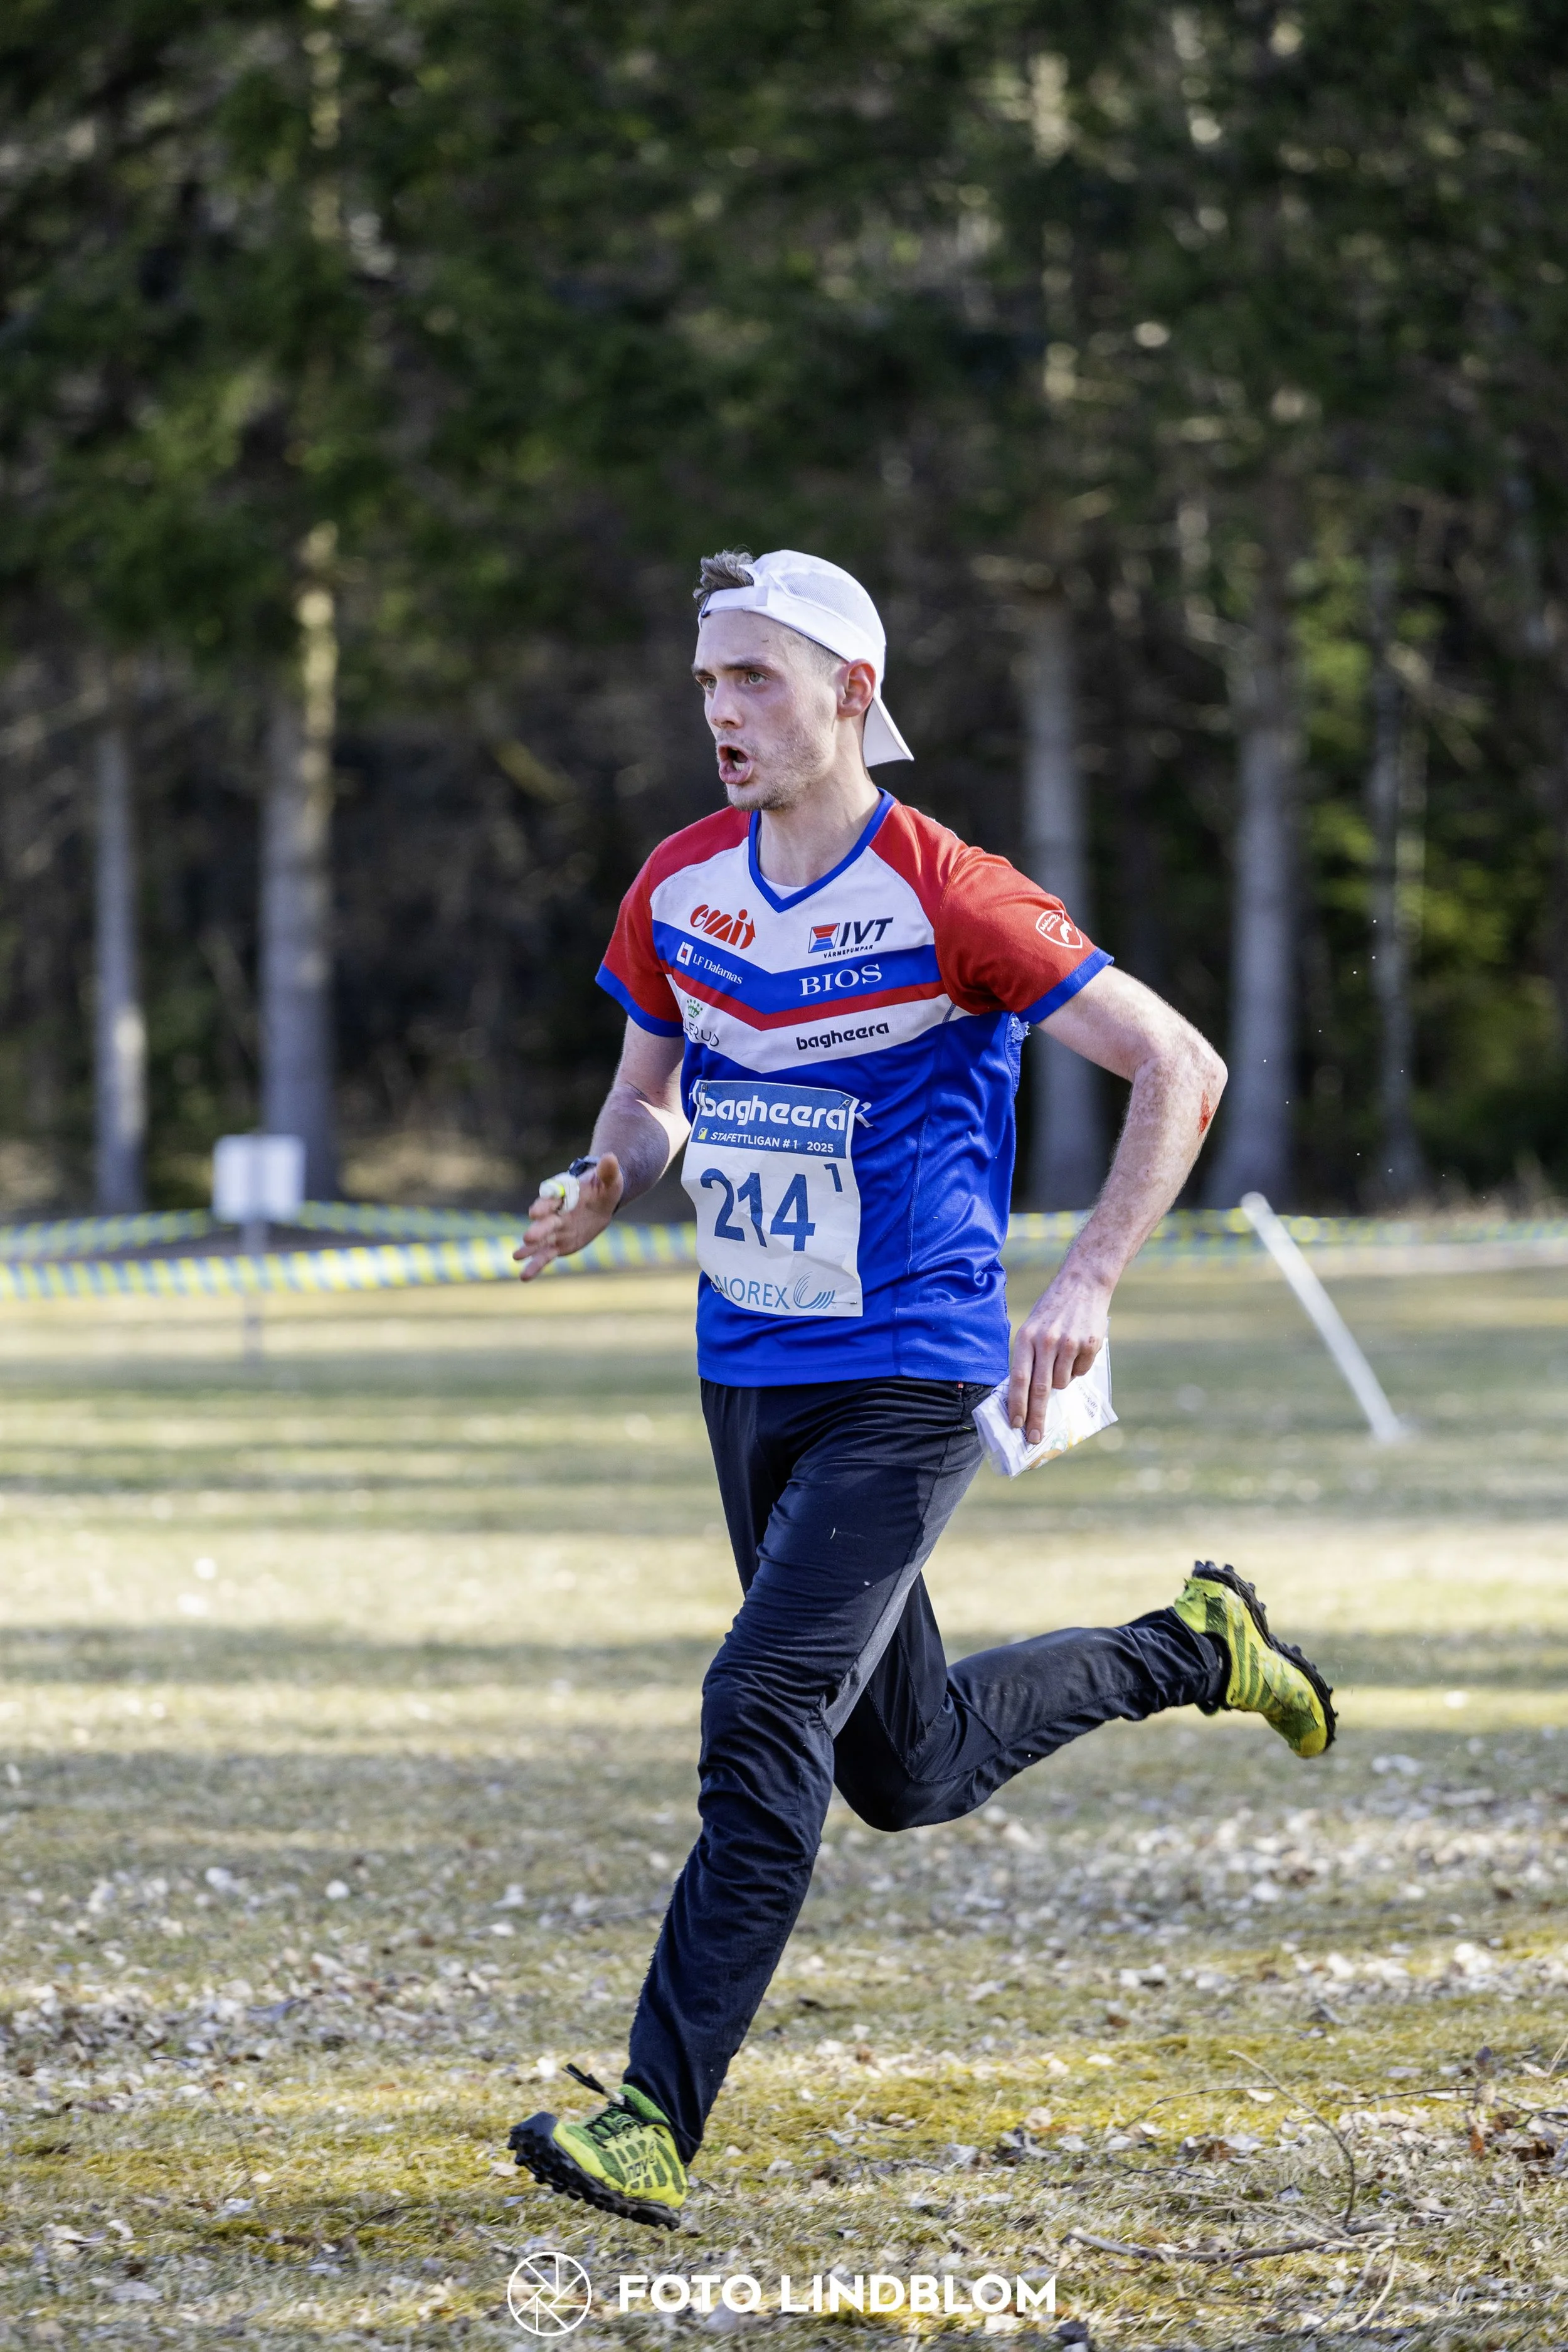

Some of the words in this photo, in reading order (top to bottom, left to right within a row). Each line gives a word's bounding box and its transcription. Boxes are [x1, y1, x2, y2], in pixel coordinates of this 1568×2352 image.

[839, 916, 894, 947] IVT
[692, 953, 704, 966] LF
[703, 959, 743, 985] Dalarnas
[798, 963, 882, 996] BIOS
[796, 1022, 890, 1051] bagheera
[698, 1092, 847, 1131] bagheera
[710, 1131, 780, 1148] STAFETTLIGAN
[807, 1142, 834, 1153] 2025
[824, 1163, 843, 1192] 1
[700, 1168, 816, 1252] 214
[714, 1274, 790, 1310] NOREX
